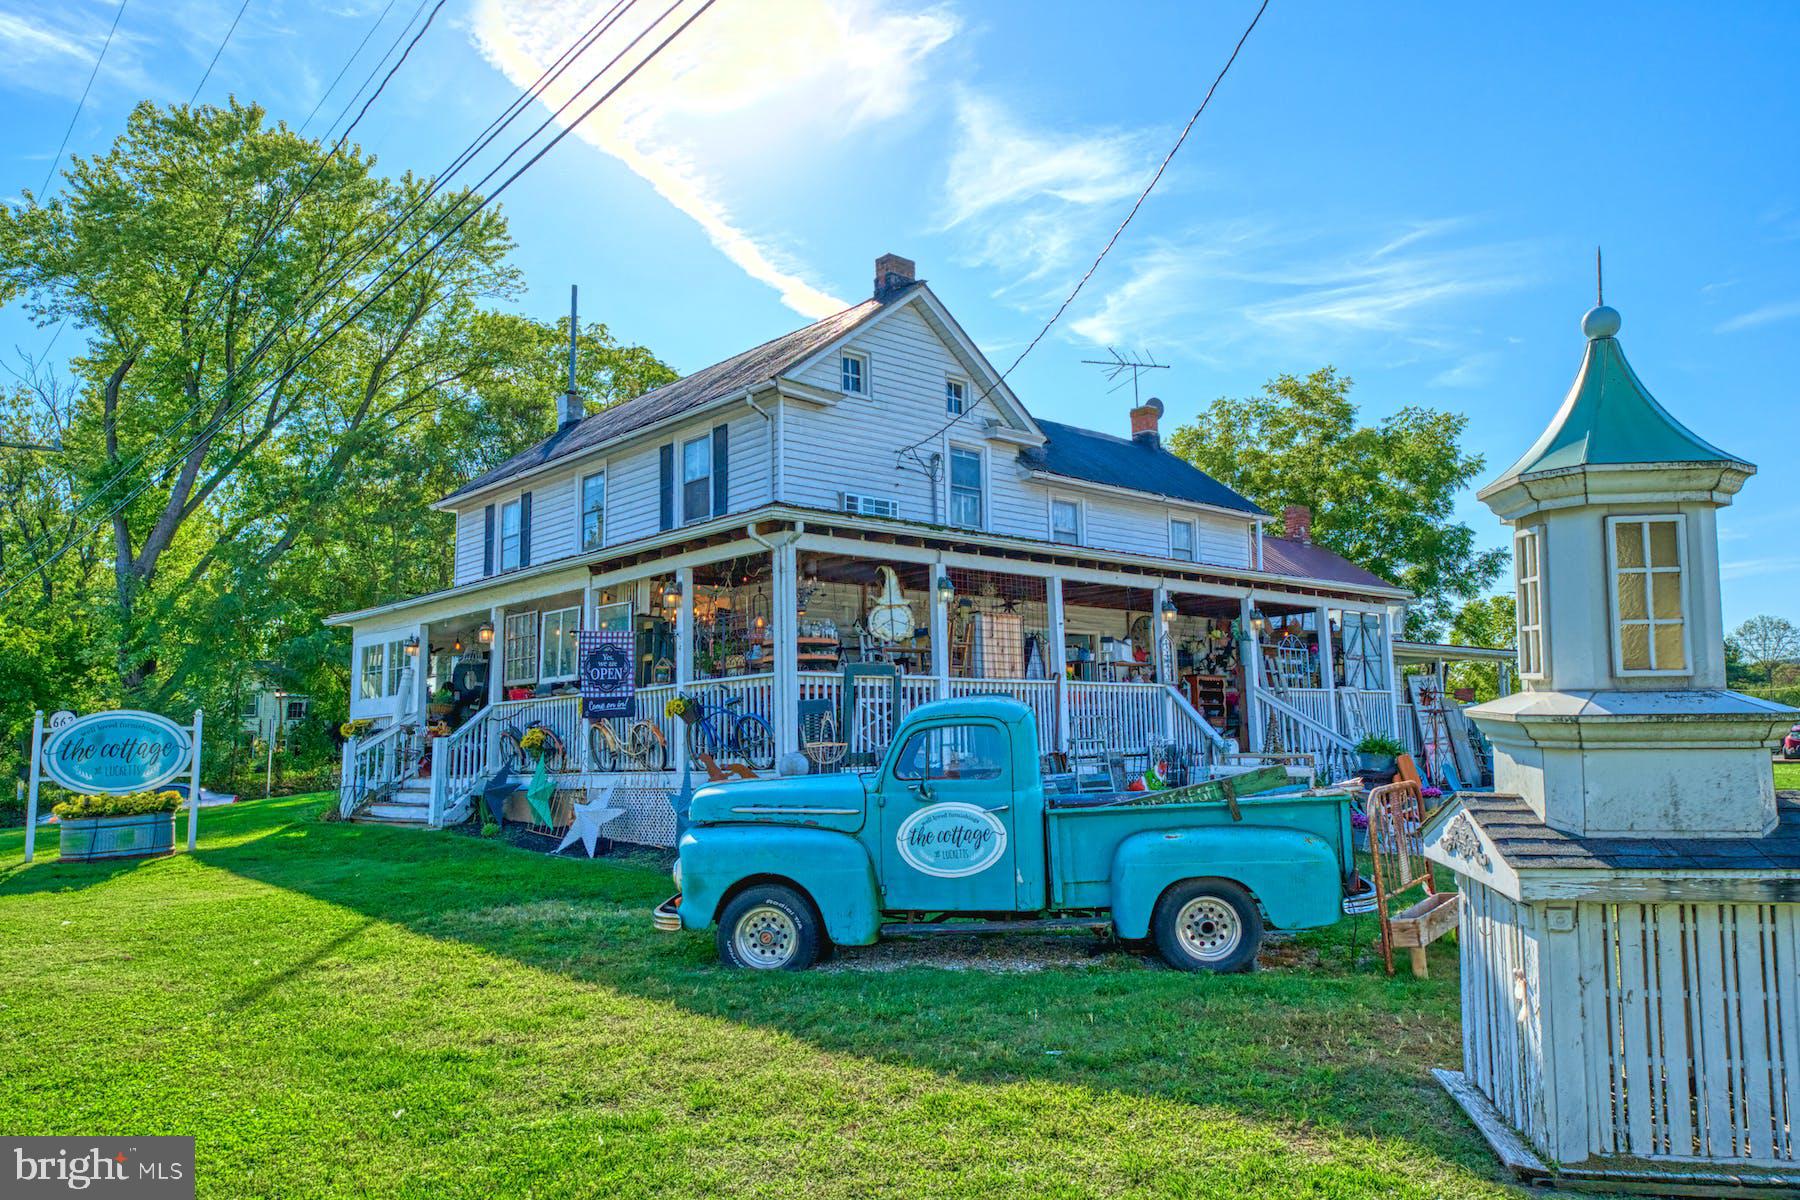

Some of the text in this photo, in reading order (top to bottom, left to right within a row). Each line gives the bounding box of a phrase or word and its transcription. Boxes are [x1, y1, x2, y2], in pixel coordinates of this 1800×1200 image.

[590, 668, 623, 680] OPEN
[588, 700, 606, 711] Come
[617, 697, 629, 708] in!
[60, 736, 174, 766] the cottage
[104, 764, 141, 777] LUCKETTS
[909, 825, 992, 850] the cottage
[942, 849, 969, 860] LUCKETTS
[766, 899, 794, 916] Radial
